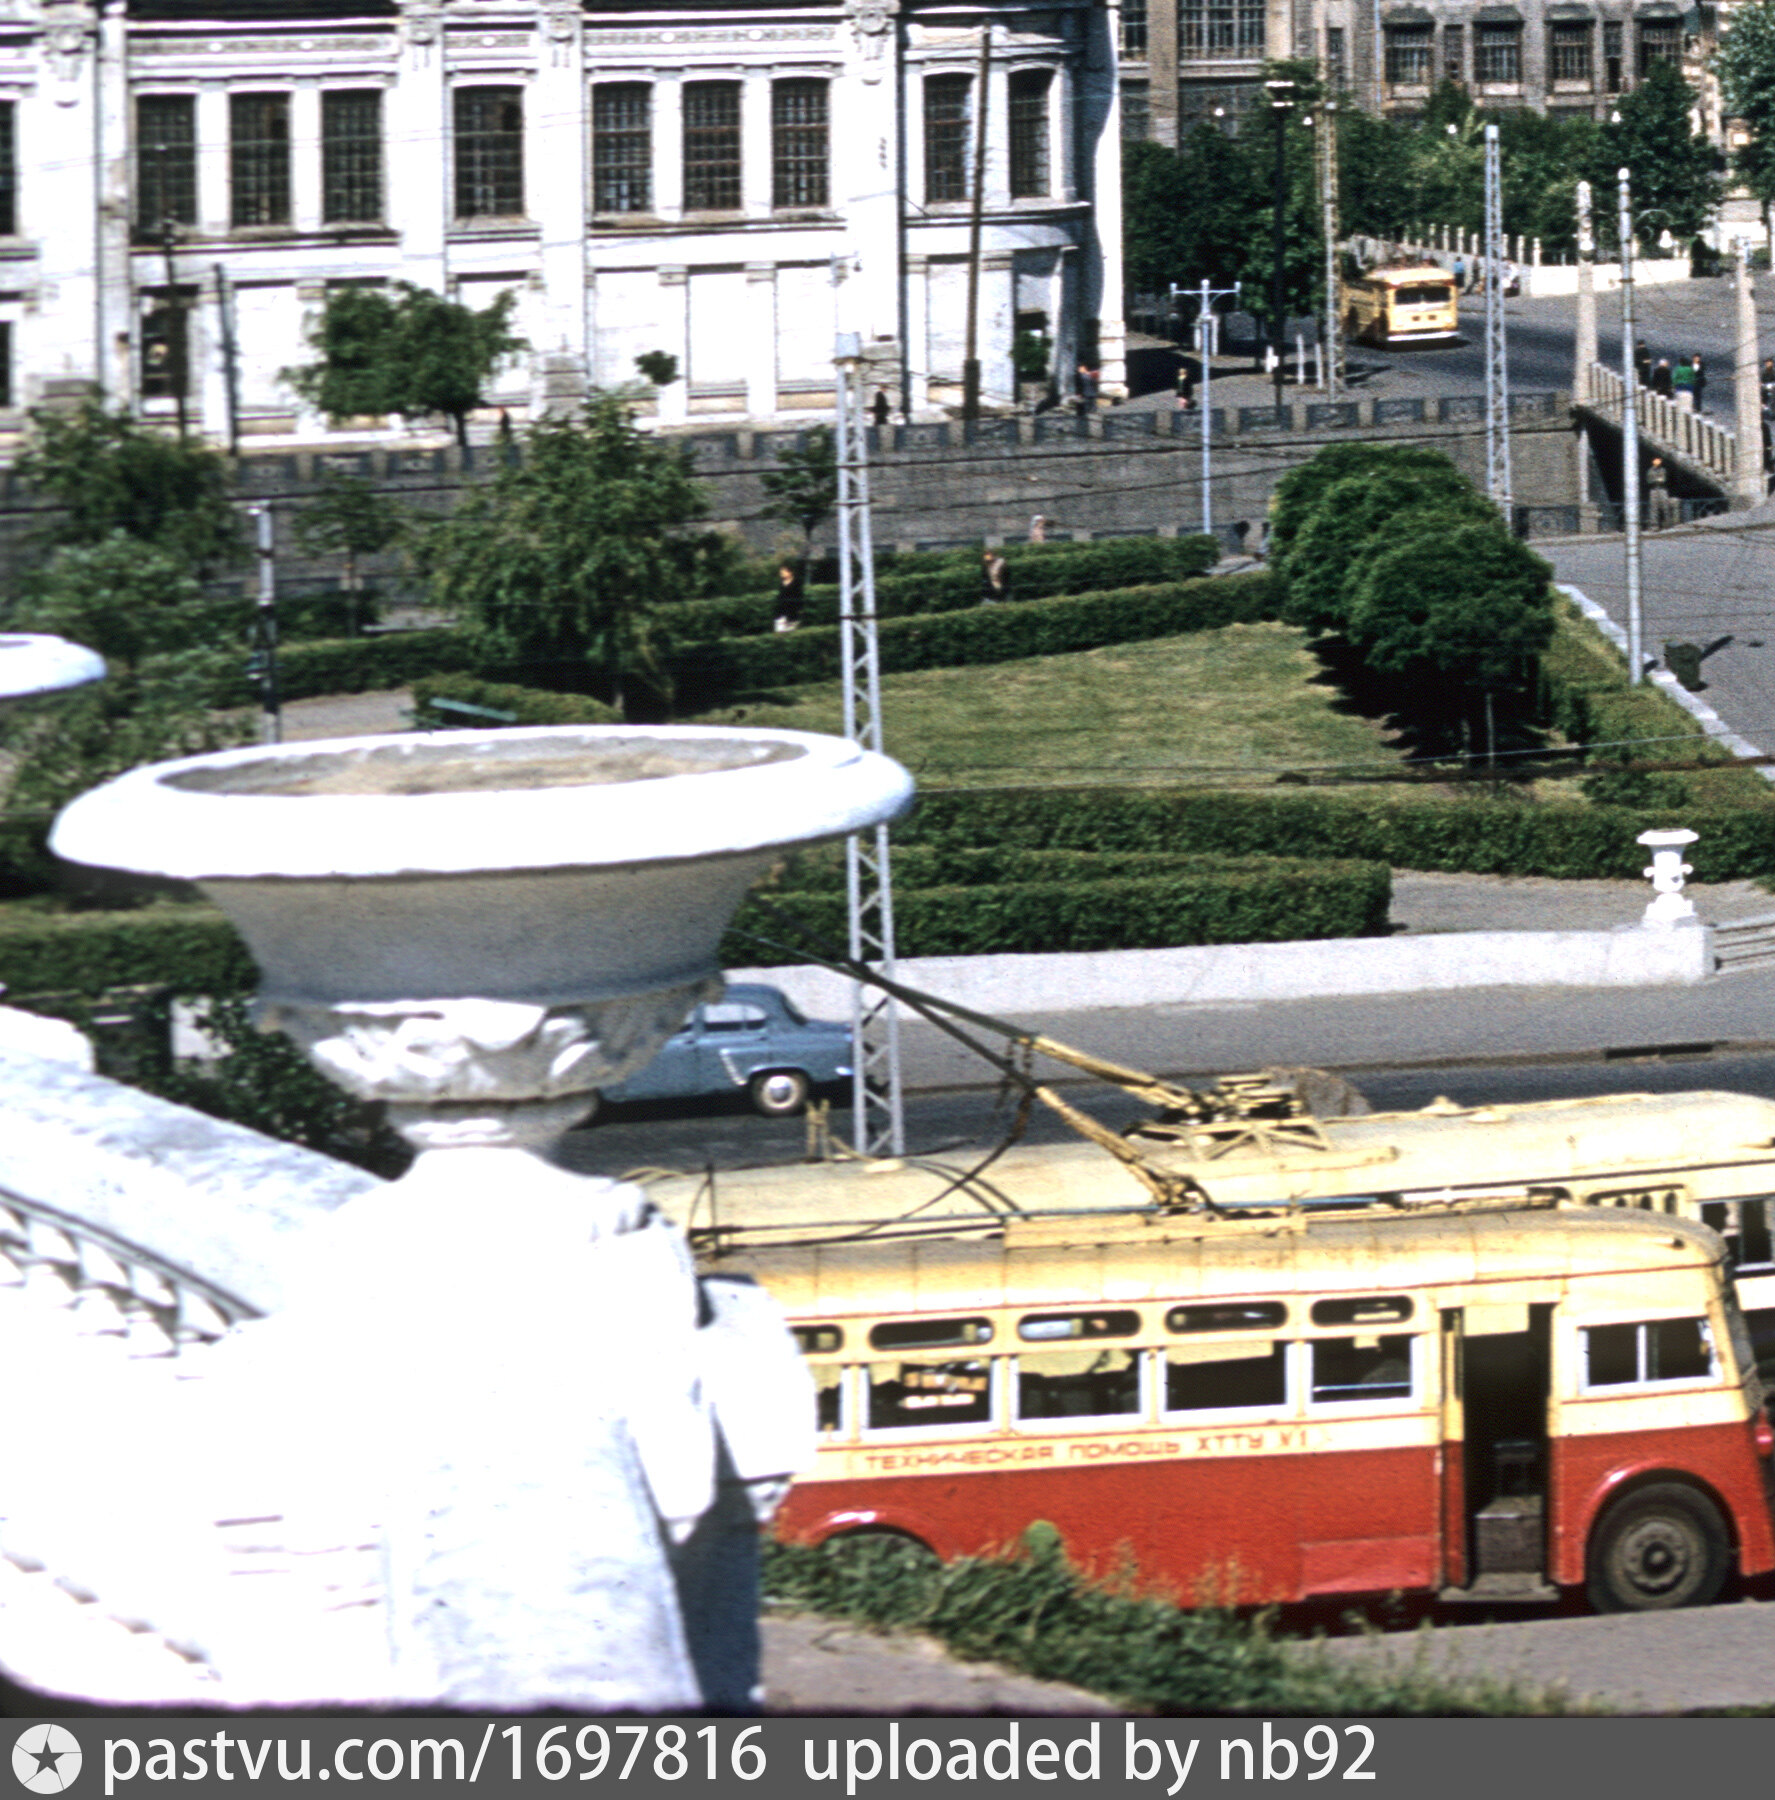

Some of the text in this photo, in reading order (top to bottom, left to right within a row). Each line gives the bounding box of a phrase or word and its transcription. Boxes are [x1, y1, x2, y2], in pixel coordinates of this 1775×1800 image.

[865, 1446, 1054, 1470] ТЕХНИЧЕСКАЯ
[1069, 1441, 1180, 1459] ПОМОЩЬ
[1197, 1433, 1263, 1451] ХТТУ
